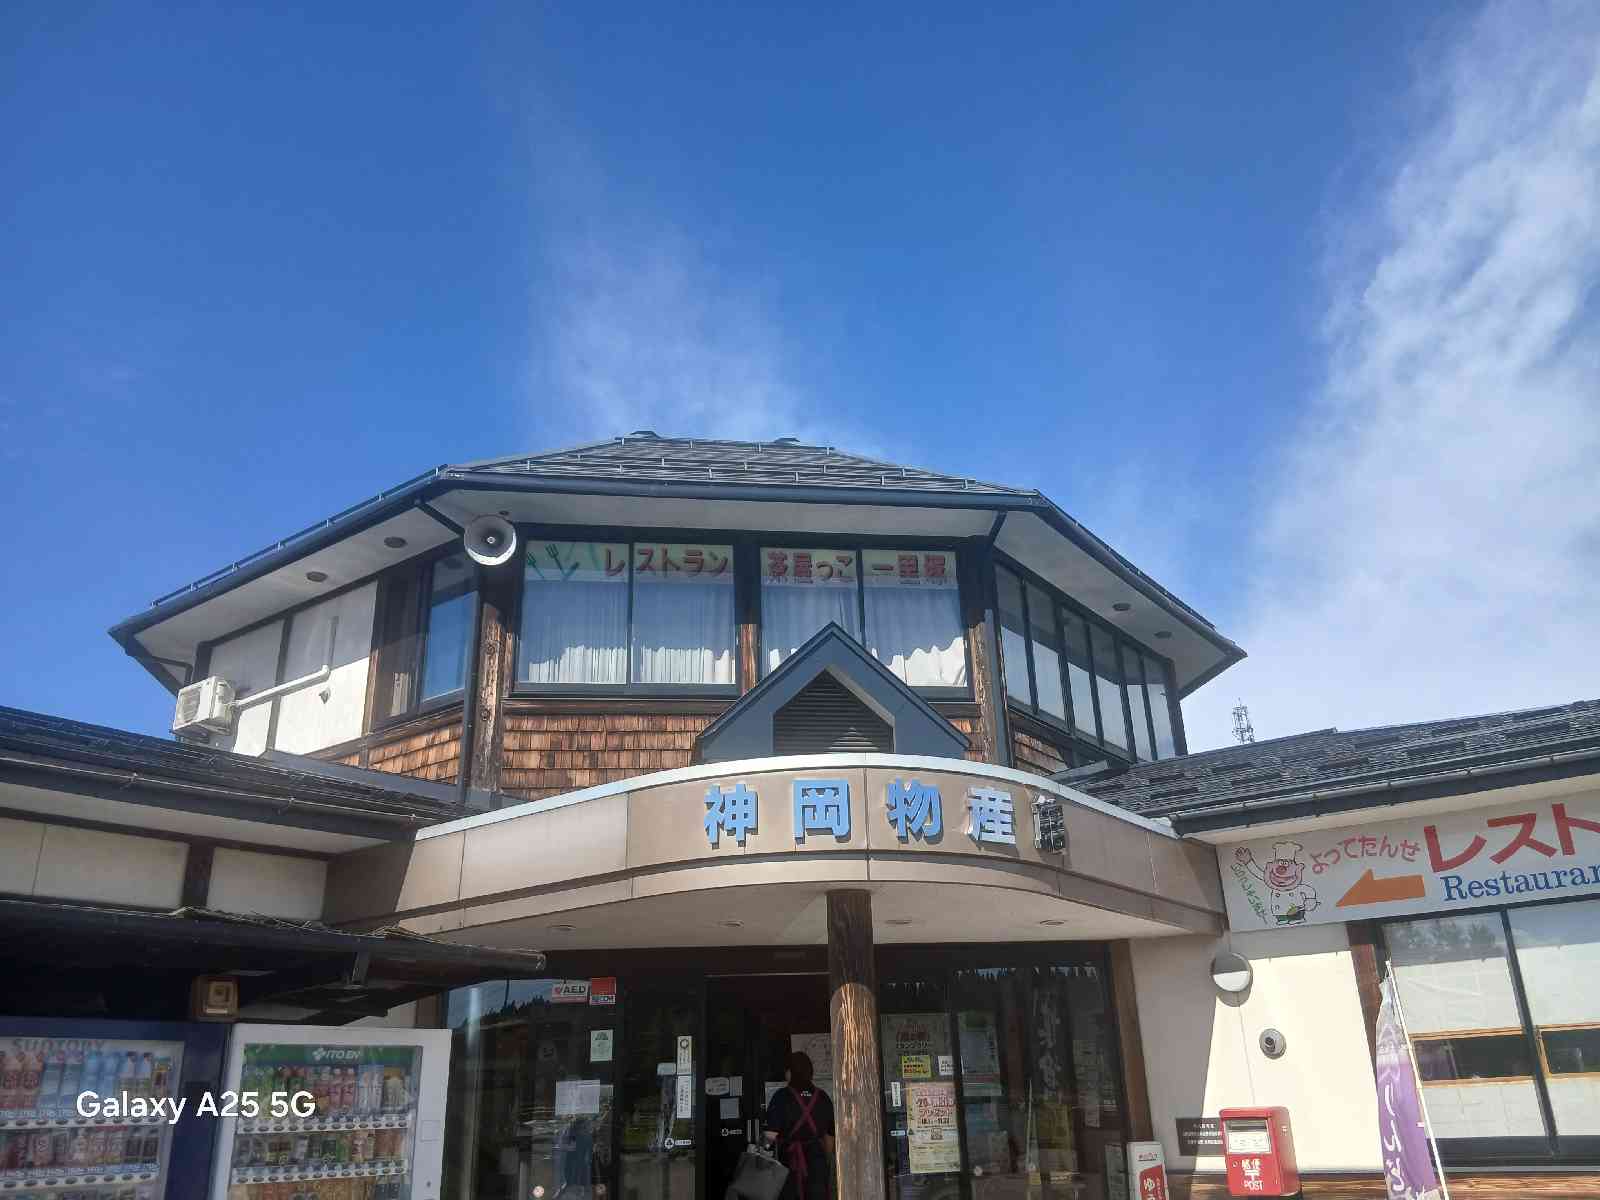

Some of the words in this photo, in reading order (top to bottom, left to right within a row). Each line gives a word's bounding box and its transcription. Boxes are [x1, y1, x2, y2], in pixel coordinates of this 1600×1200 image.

[605, 547, 729, 577] レストラン
[703, 778, 1017, 848] 神岡物産
[1310, 832, 1420, 874] よってたんせ
[1423, 803, 1600, 873] レスト
[563, 984, 586, 995] AED
[1243, 1180, 1264, 1191] POST
